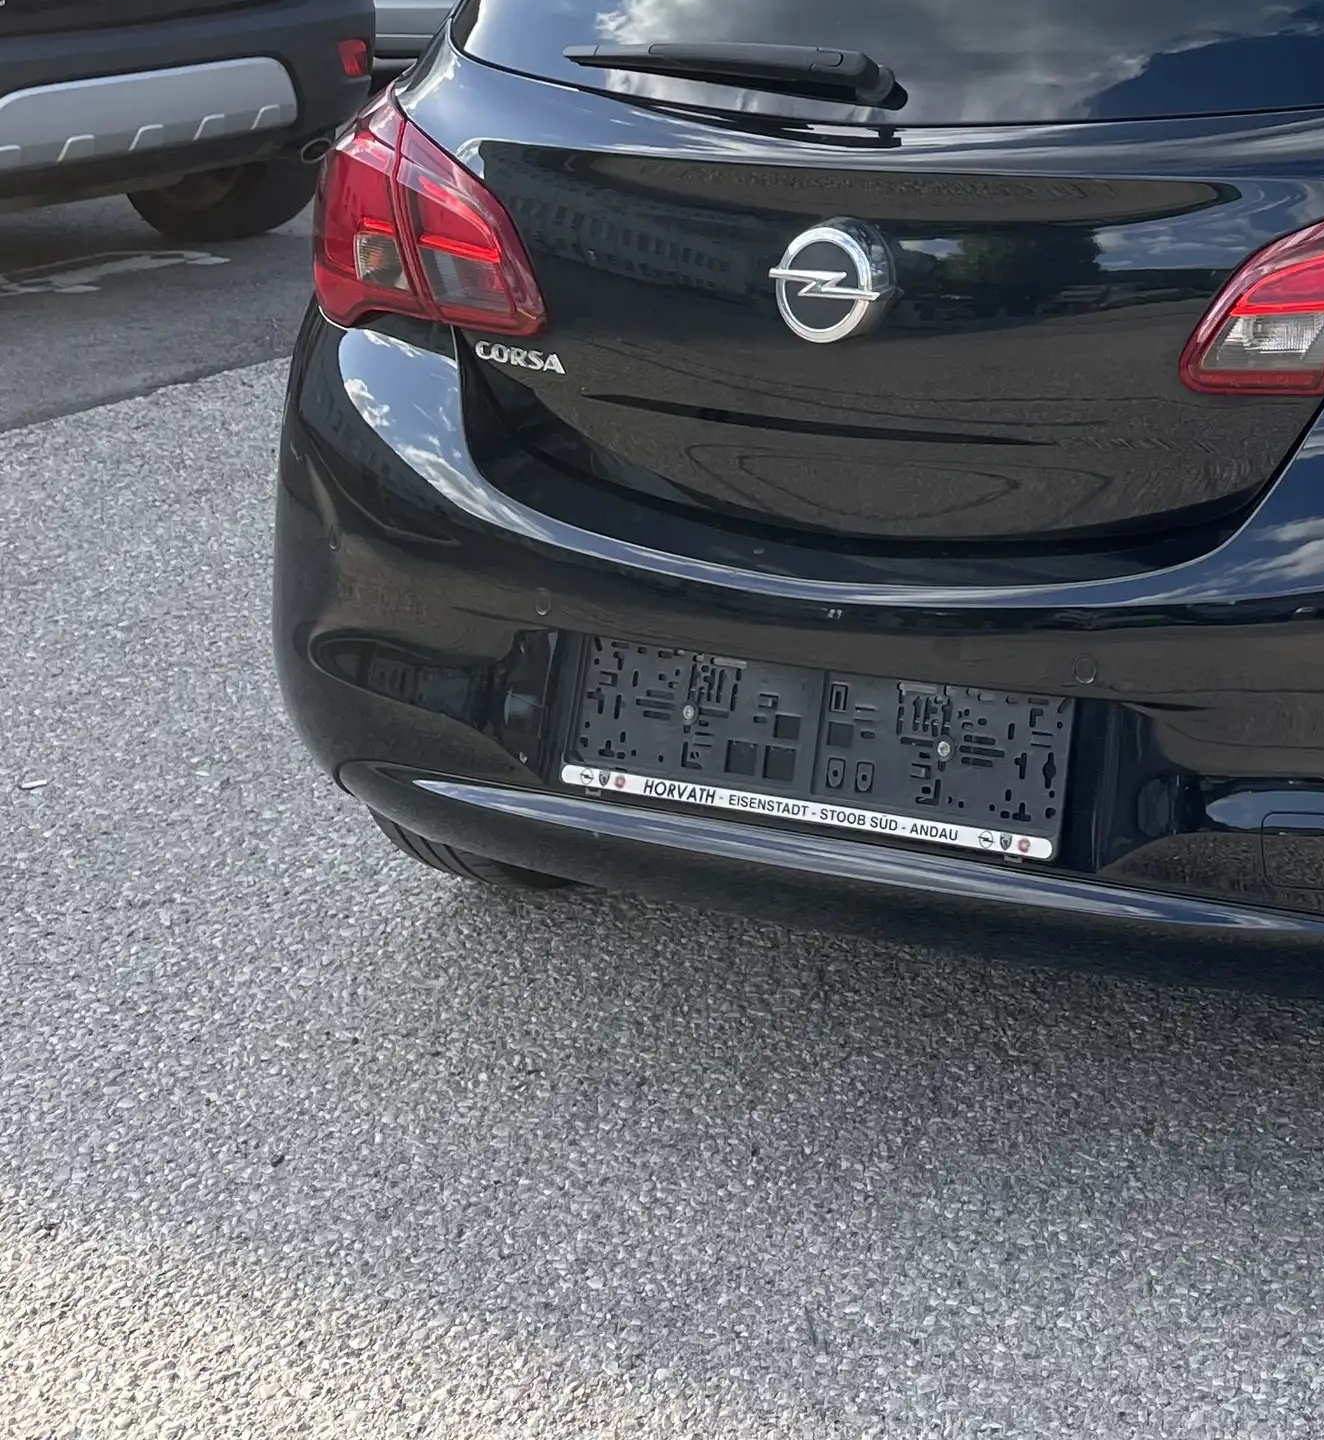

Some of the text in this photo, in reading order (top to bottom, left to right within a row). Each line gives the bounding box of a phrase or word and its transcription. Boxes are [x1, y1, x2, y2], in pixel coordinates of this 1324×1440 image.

[475, 340, 566, 375] CORSA
[642, 779, 716, 804] HORVATH
[728, 793, 810, 817] EISENSTADT
[819, 808, 867, 826] STOOB
[870, 814, 899, 832] SÜD
[909, 822, 959, 842] ANDAU
